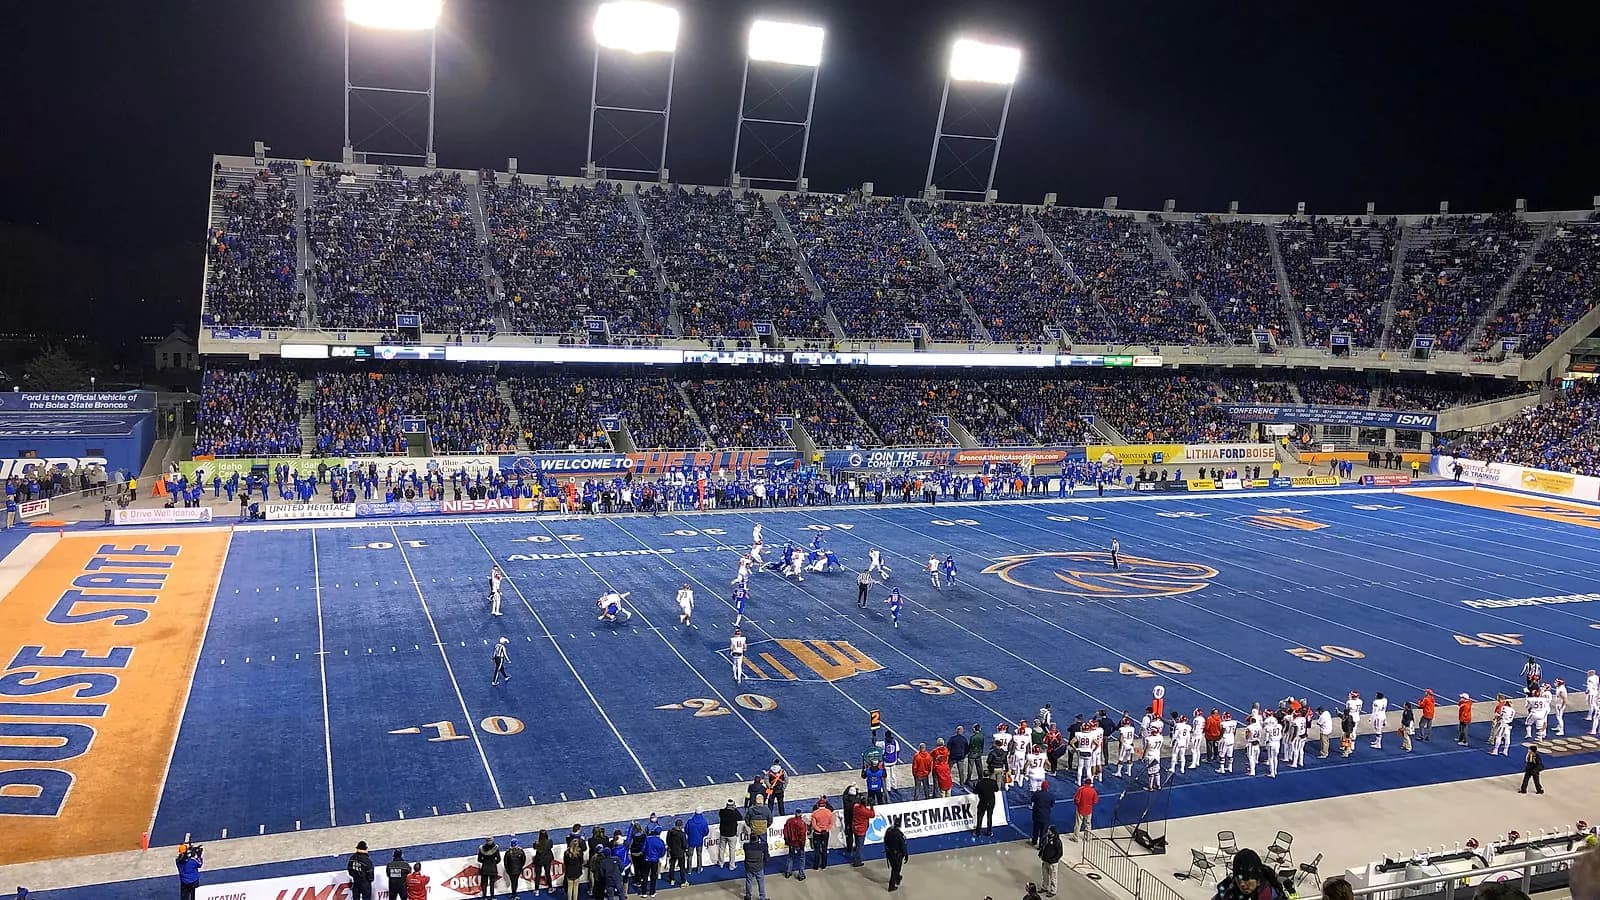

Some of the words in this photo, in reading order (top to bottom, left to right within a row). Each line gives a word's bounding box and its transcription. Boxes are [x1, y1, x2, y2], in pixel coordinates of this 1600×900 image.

[1228, 407, 1280, 415] CONFERENCE
[1396, 414, 1433, 426] ISMI
[868, 451, 894, 461] JOIN
[896, 451, 919, 461] THE
[920, 450, 951, 461] TEAM
[218, 462, 243, 470] Idaho
[541, 458, 611, 471] WELCOME
[614, 458, 634, 469] TO
[625, 452, 686, 474] THE
[867, 460, 899, 468] COMMIT
[915, 459, 932, 467] THE
[1470, 471, 1500, 480] TRAINING
[1485, 466, 1501, 475] PETS
[21, 500, 48, 514] ESPN
[269, 503, 305, 514] UNITED
[306, 502, 353, 512] HERITAGE
[443, 496, 513, 512] NISSAN
[130, 509, 152, 518] Drive
[277, 511, 345, 519] INSURANCE
[506, 548, 676, 562] Albertsons
[681, 543, 784, 553] STADUM
[43, 543, 184, 627] STATE
[1453, 632, 1524, 648] 40
[1284, 644, 1367, 664] 50
[1118, 658, 1193, 678] 40
[908, 675, 999, 696] 30
[682, 693, 779, 717] 20
[871, 711, 880, 725] 2
[420, 715, 526, 743] 10
[1019, 740, 1026, 750] 2
[1080, 737, 1090, 746] 88
[1033, 757, 1043, 768] 57
[887, 803, 974, 829] WESTMARK
[924, 822, 949, 832] CREDIT
[950, 818, 974, 828] UNION
[703, 837, 720, 848] Give
[523, 864, 563, 879] OIN
[450, 875, 482, 889] ORKI
